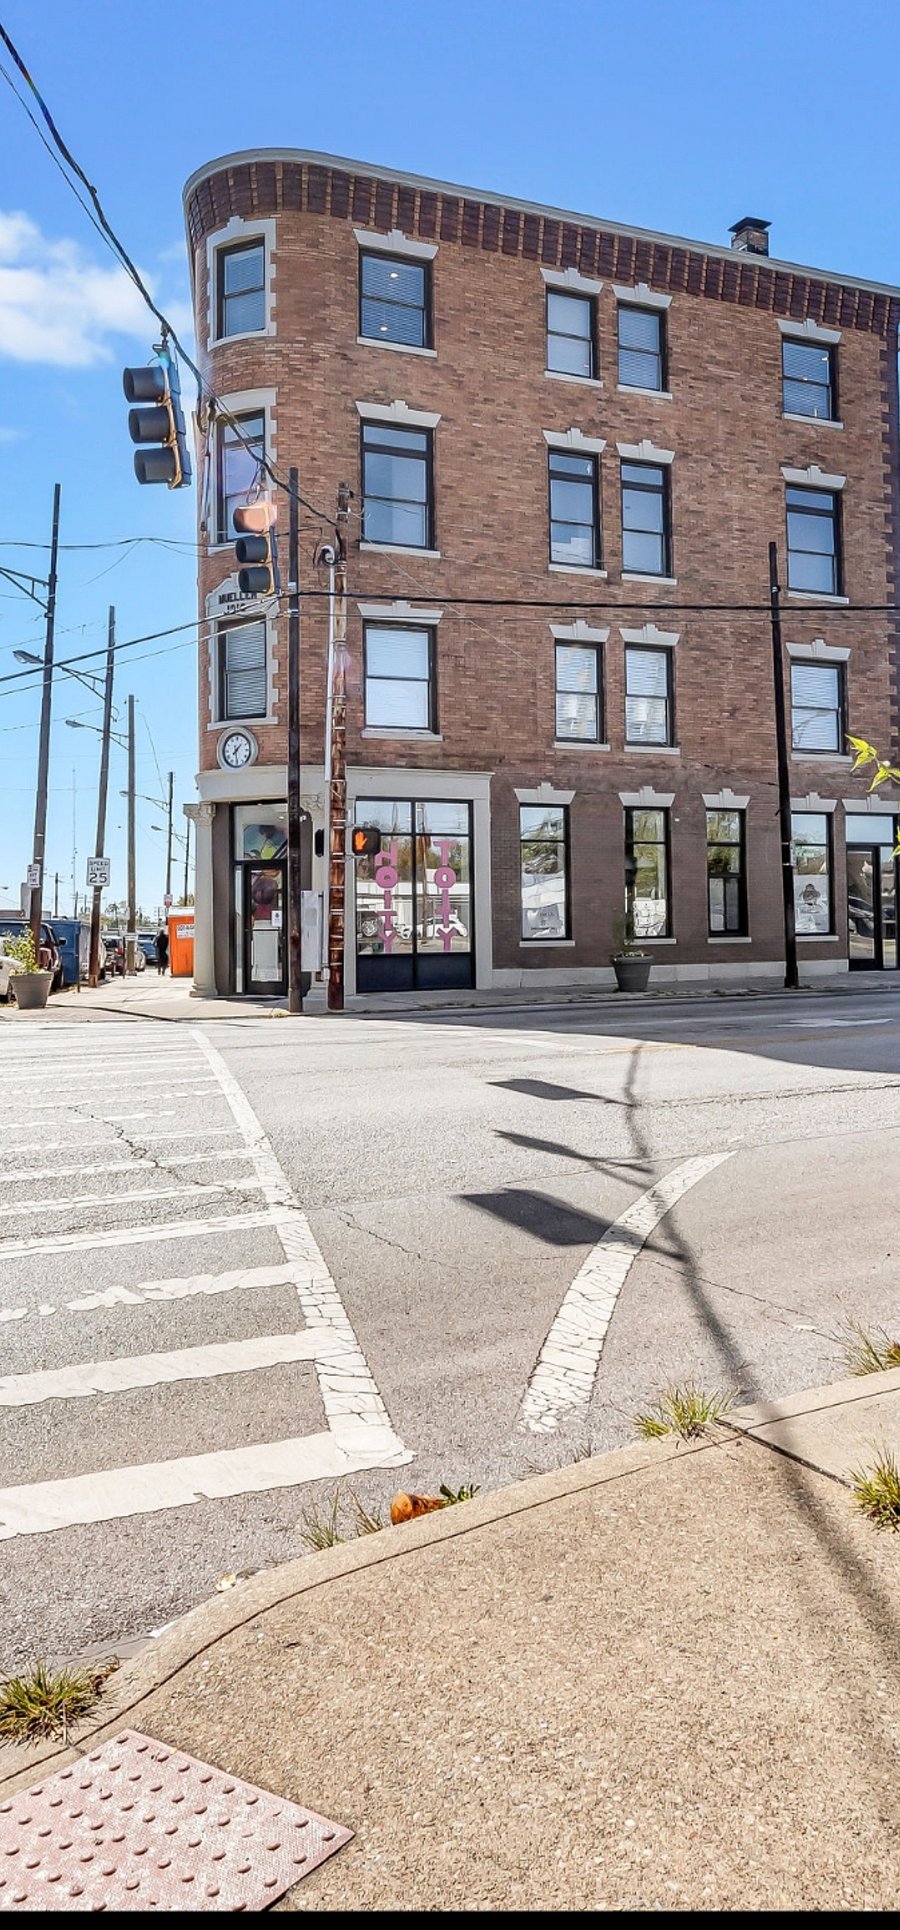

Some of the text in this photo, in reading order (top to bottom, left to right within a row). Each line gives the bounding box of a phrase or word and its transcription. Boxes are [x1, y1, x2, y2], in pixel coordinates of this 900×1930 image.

[218, 591, 258, 604] MUELLER
[89, 873, 108, 883] 25
[374, 840, 398, 953] HOITY
[433, 840, 457, 953] TOITY
